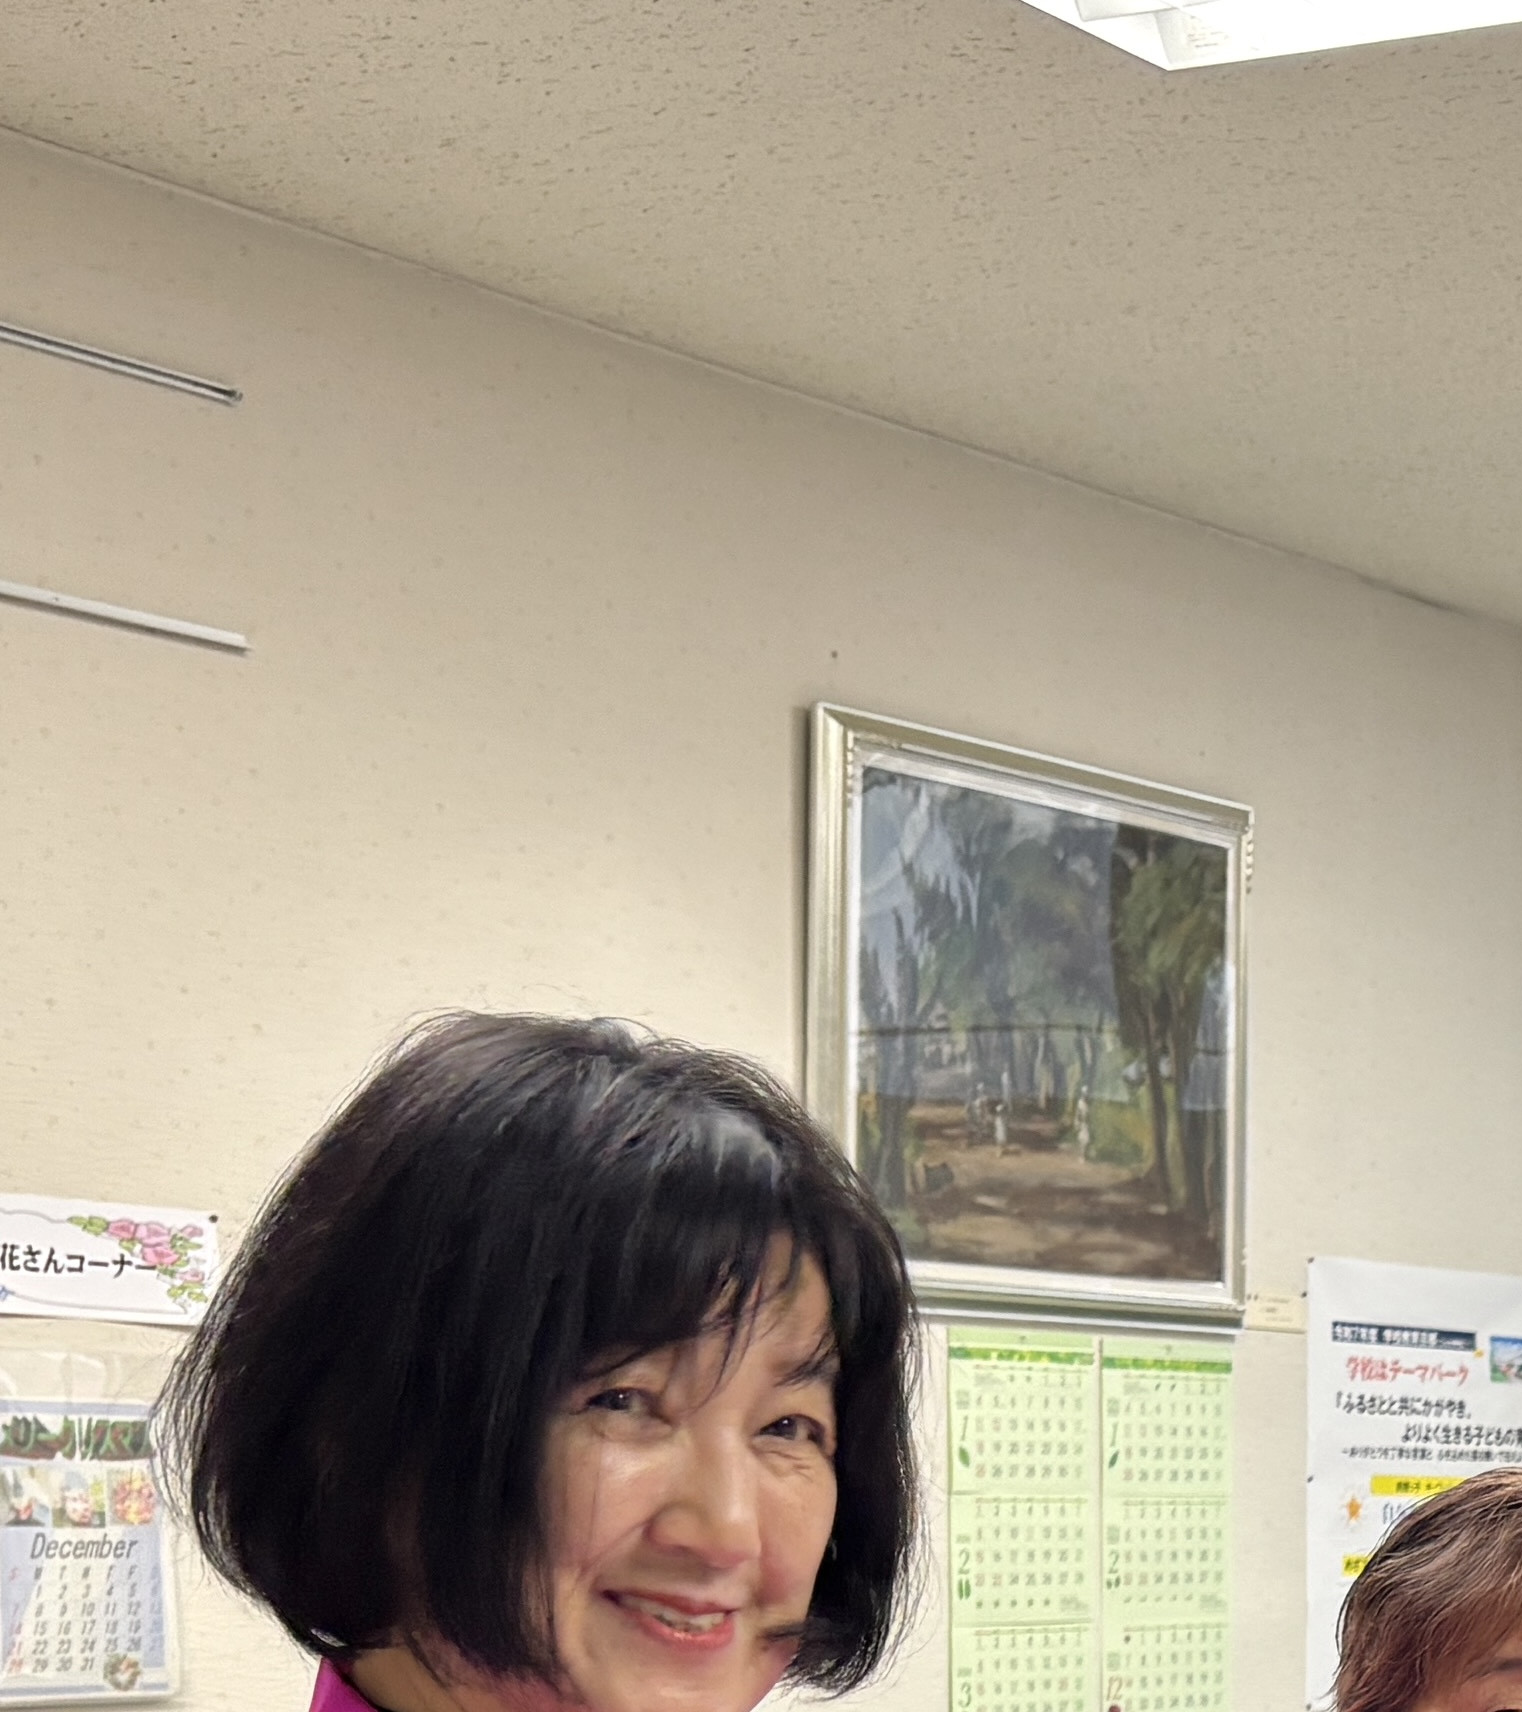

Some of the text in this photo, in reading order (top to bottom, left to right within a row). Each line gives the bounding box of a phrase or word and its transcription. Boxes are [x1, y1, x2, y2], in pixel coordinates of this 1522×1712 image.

[30, 1532, 138, 1559] December
[81, 1602, 95, 1617] 10
[104, 1602, 117, 1616] 11
[33, 1621, 47, 1636] 15
[57, 1620, 72, 1636] 16
[81, 1619, 96, 1636] 17
[32, 1639, 48, 1655] 22
[56, 1638, 72, 1655] 23
